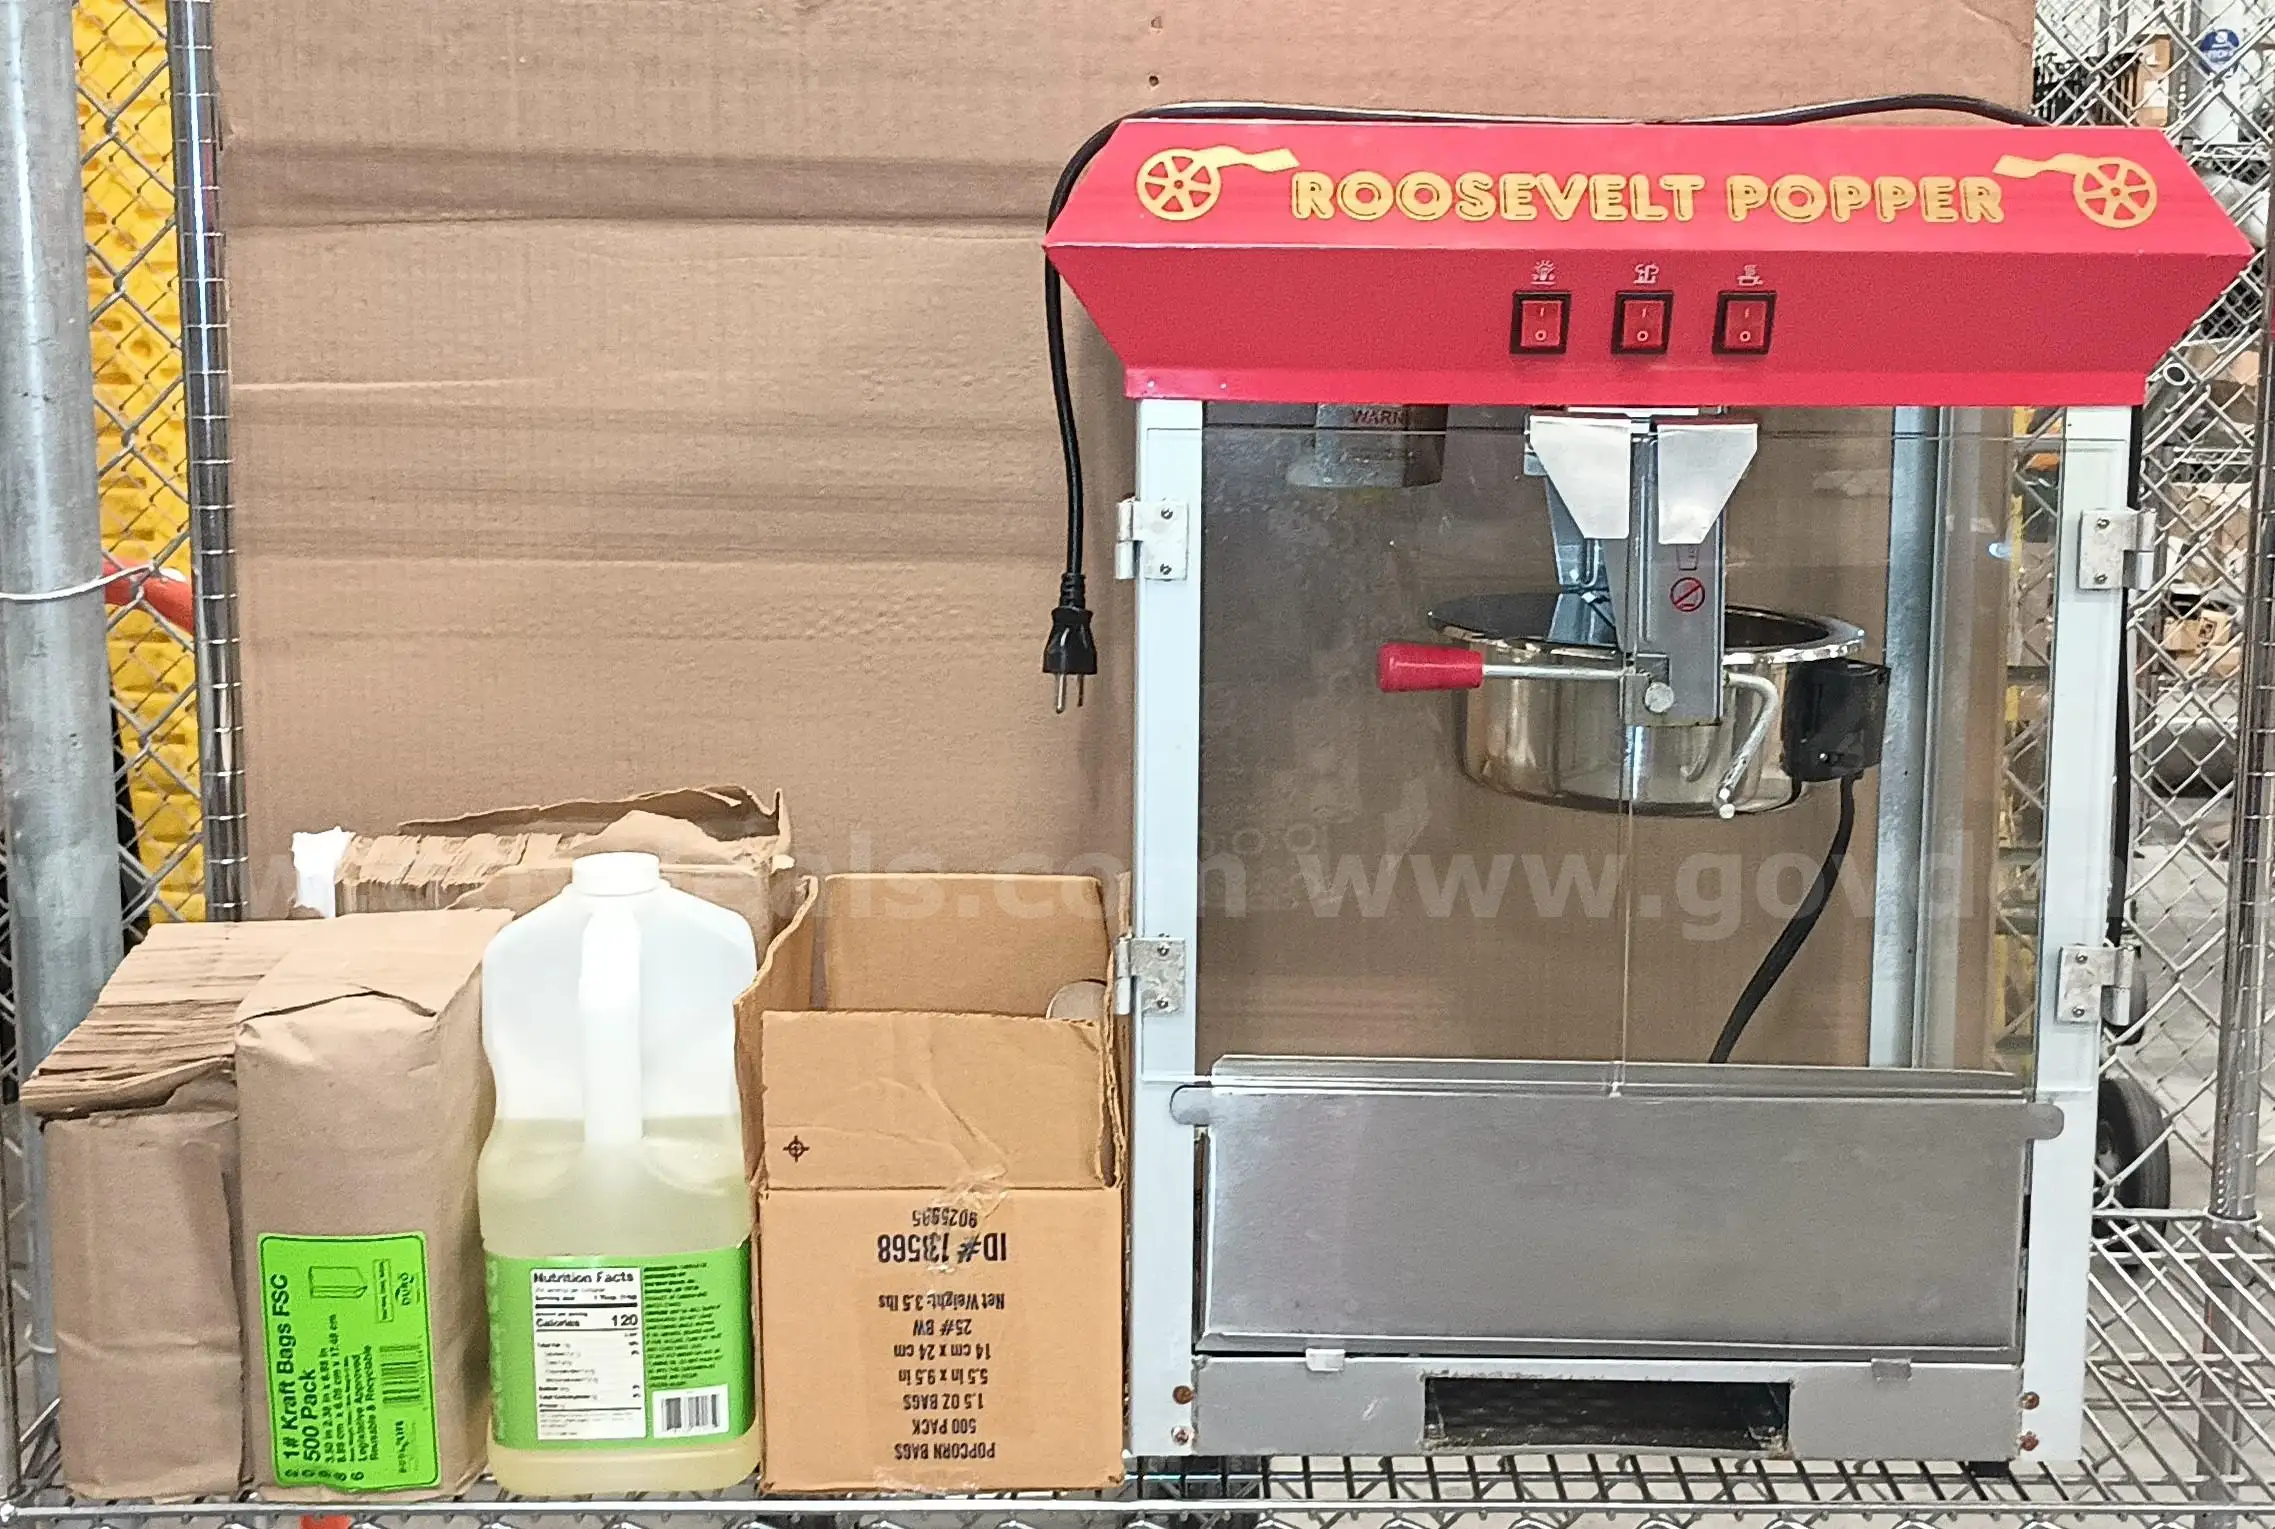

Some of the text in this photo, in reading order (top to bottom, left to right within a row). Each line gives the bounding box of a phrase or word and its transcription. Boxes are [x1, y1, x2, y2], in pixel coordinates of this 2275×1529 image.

[1291, 170, 2004, 224] ROOSEVELT POPPER
[877, 1231, 950, 1264] 13568
[533, 1271, 635, 1284] Nutrition Facts
[878, 1294, 899, 1312] lbs
[902, 1294, 924, 1312] 3.5
[981, 1293, 1005, 1310] Net
[536, 1313, 639, 1329] Calories 120
[912, 1318, 972, 1337] 25# BW
[893, 1343, 992, 1361] 14 cm x 24 cm
[270, 1273, 300, 1459] 1# Kraft Bags FSC
[939, 1368, 948, 1381] x
[898, 1368, 911, 1386] in
[914, 1368, 936, 1386] 9.5
[967, 1368, 989, 1385] 5.5
[902, 1392, 984, 1411] 1.5 OZ BAGS
[298, 1369, 321, 1462] 500 Pack
[911, 1418, 977, 1436] 500 PACK
[894, 1442, 996, 1461] POPCORN BAGS
